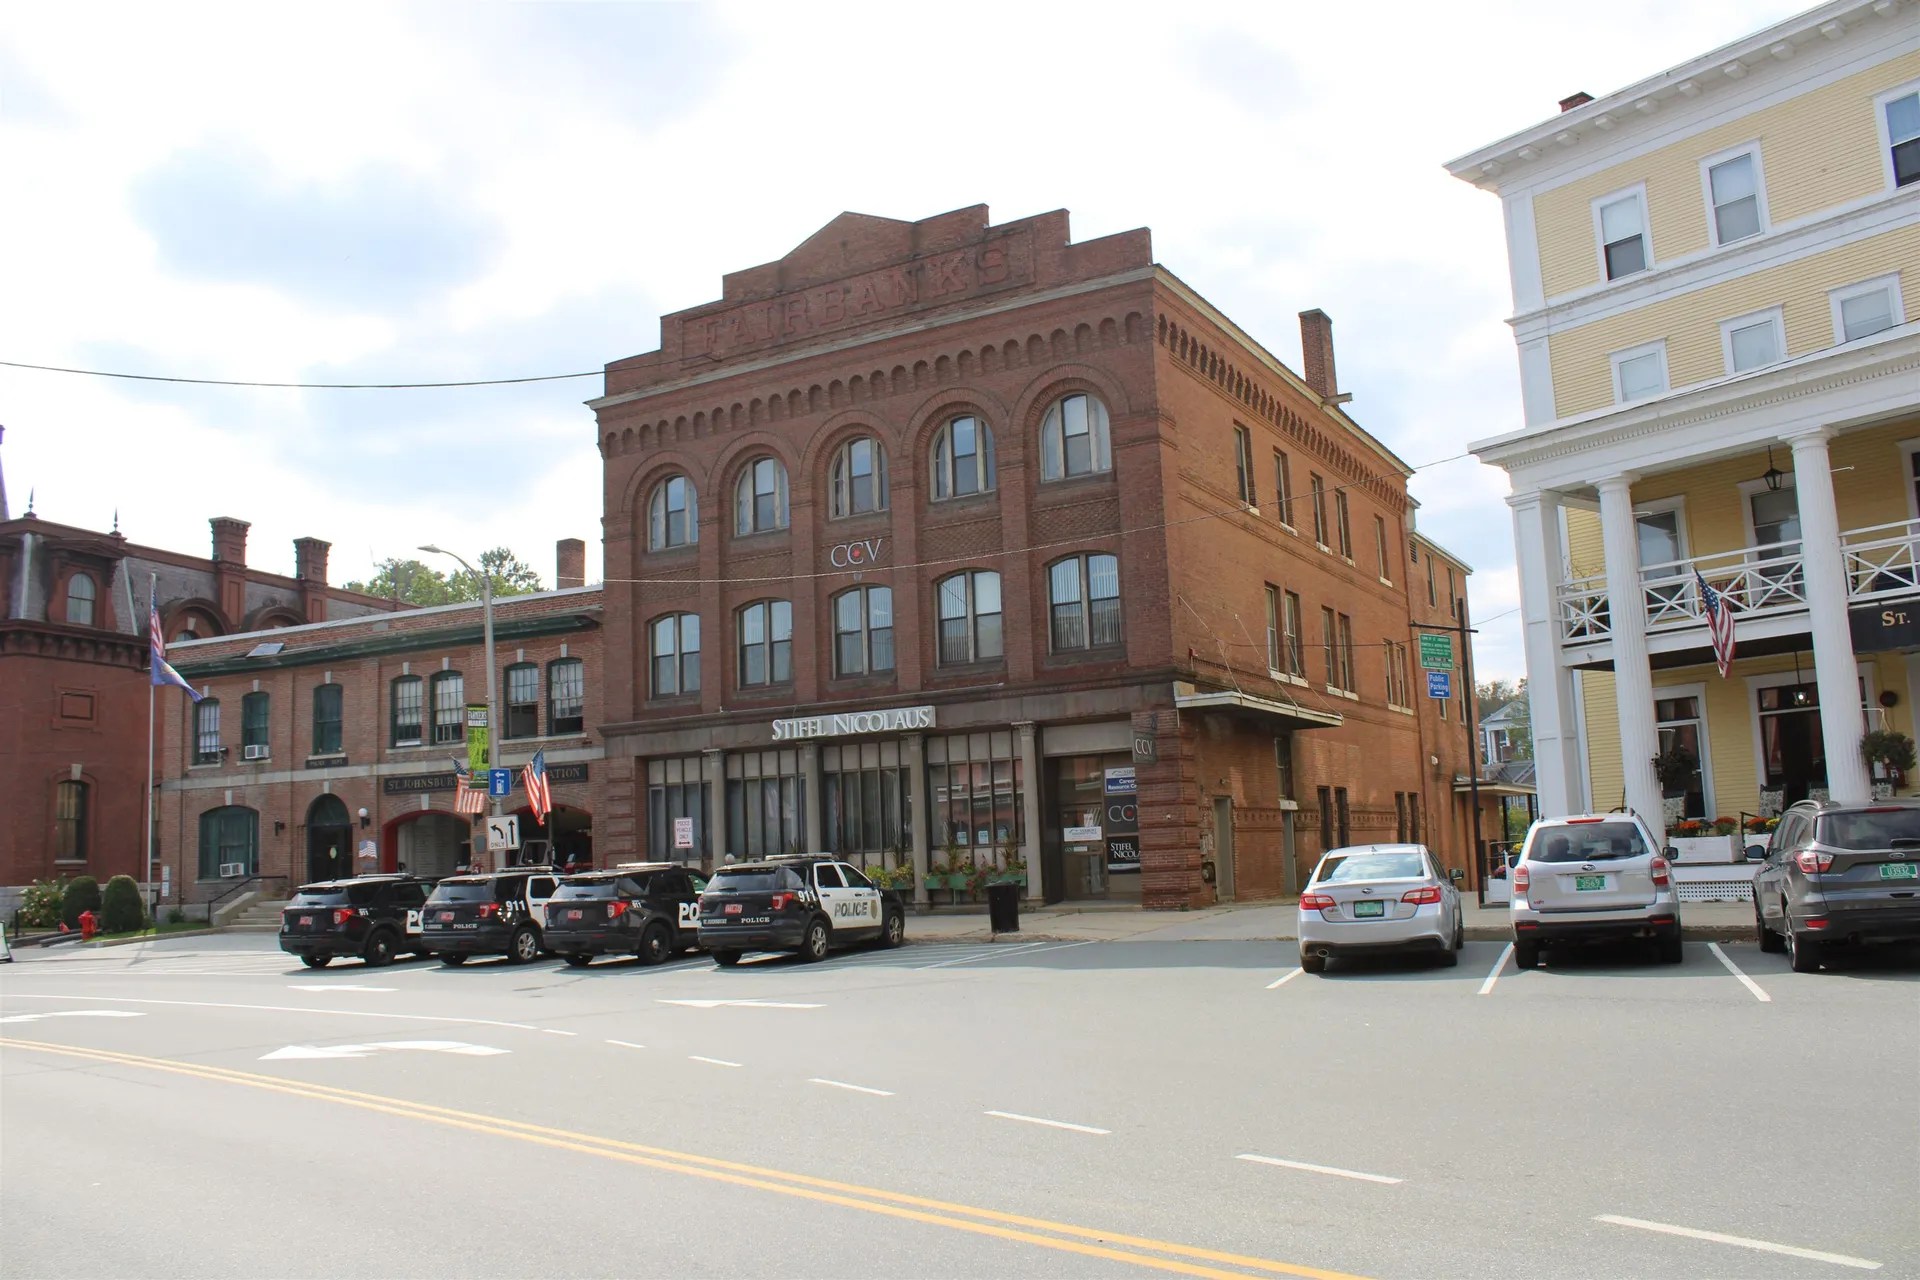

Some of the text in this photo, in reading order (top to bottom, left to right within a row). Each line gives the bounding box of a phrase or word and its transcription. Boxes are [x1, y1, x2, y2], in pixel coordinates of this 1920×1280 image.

[701, 247, 1011, 352] FAIRBANKS
[830, 538, 883, 567] CCV
[1881, 610, 1911, 627] ST.
[1429, 674, 1445, 682] Public
[1430, 682, 1449, 692] Parking
[772, 708, 930, 740] STIFEL NICOLAUS
[1135, 738, 1153, 755] CCV
[1110, 843, 1133, 851] STIFEL
[798, 889, 818, 903] 911
[505, 900, 526, 911] 911
[834, 901, 868, 918] POLICE
[741, 916, 770, 925] POLICE
